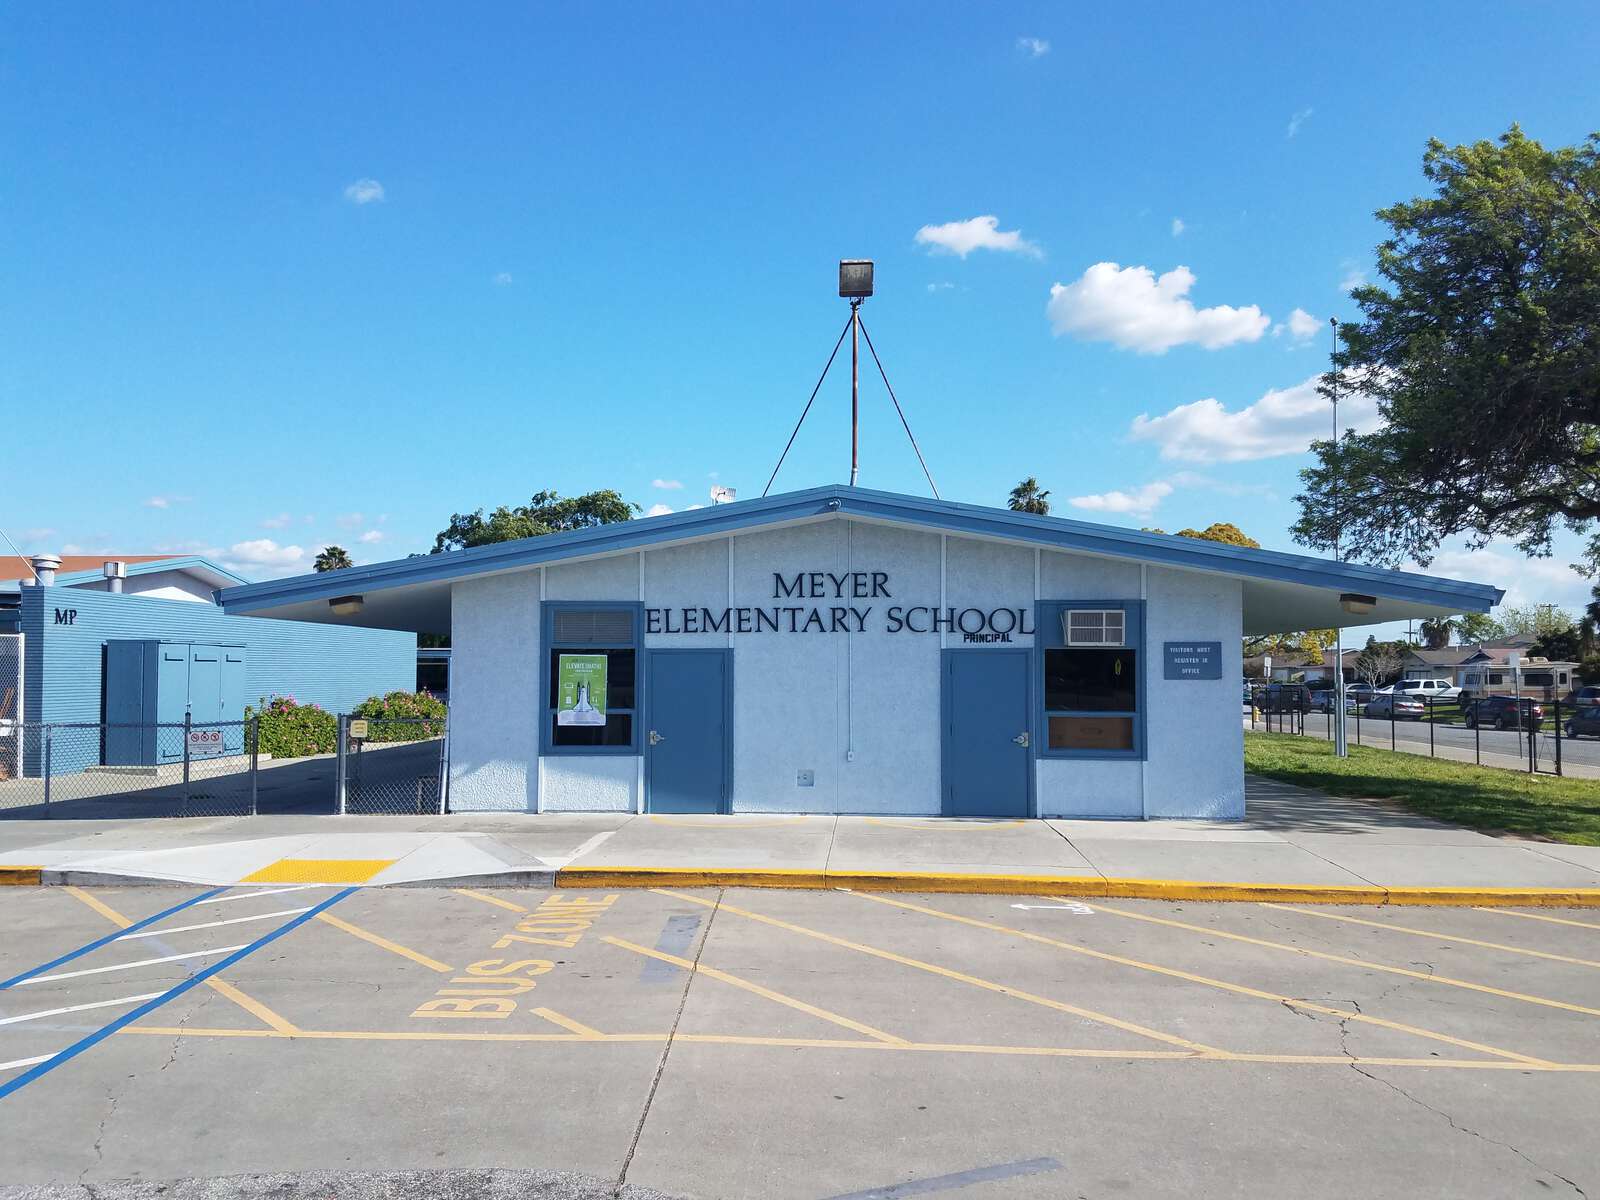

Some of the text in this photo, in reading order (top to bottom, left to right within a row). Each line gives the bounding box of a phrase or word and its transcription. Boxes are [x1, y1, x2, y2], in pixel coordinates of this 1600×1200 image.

[772, 572, 892, 598] MEYER
[55, 608, 77, 625] MP
[645, 606, 1036, 634] ELEMENTARY SCHOOL
[963, 633, 1013, 643] PRINCIPAL
[408, 894, 620, 1018] BUS ZONE
